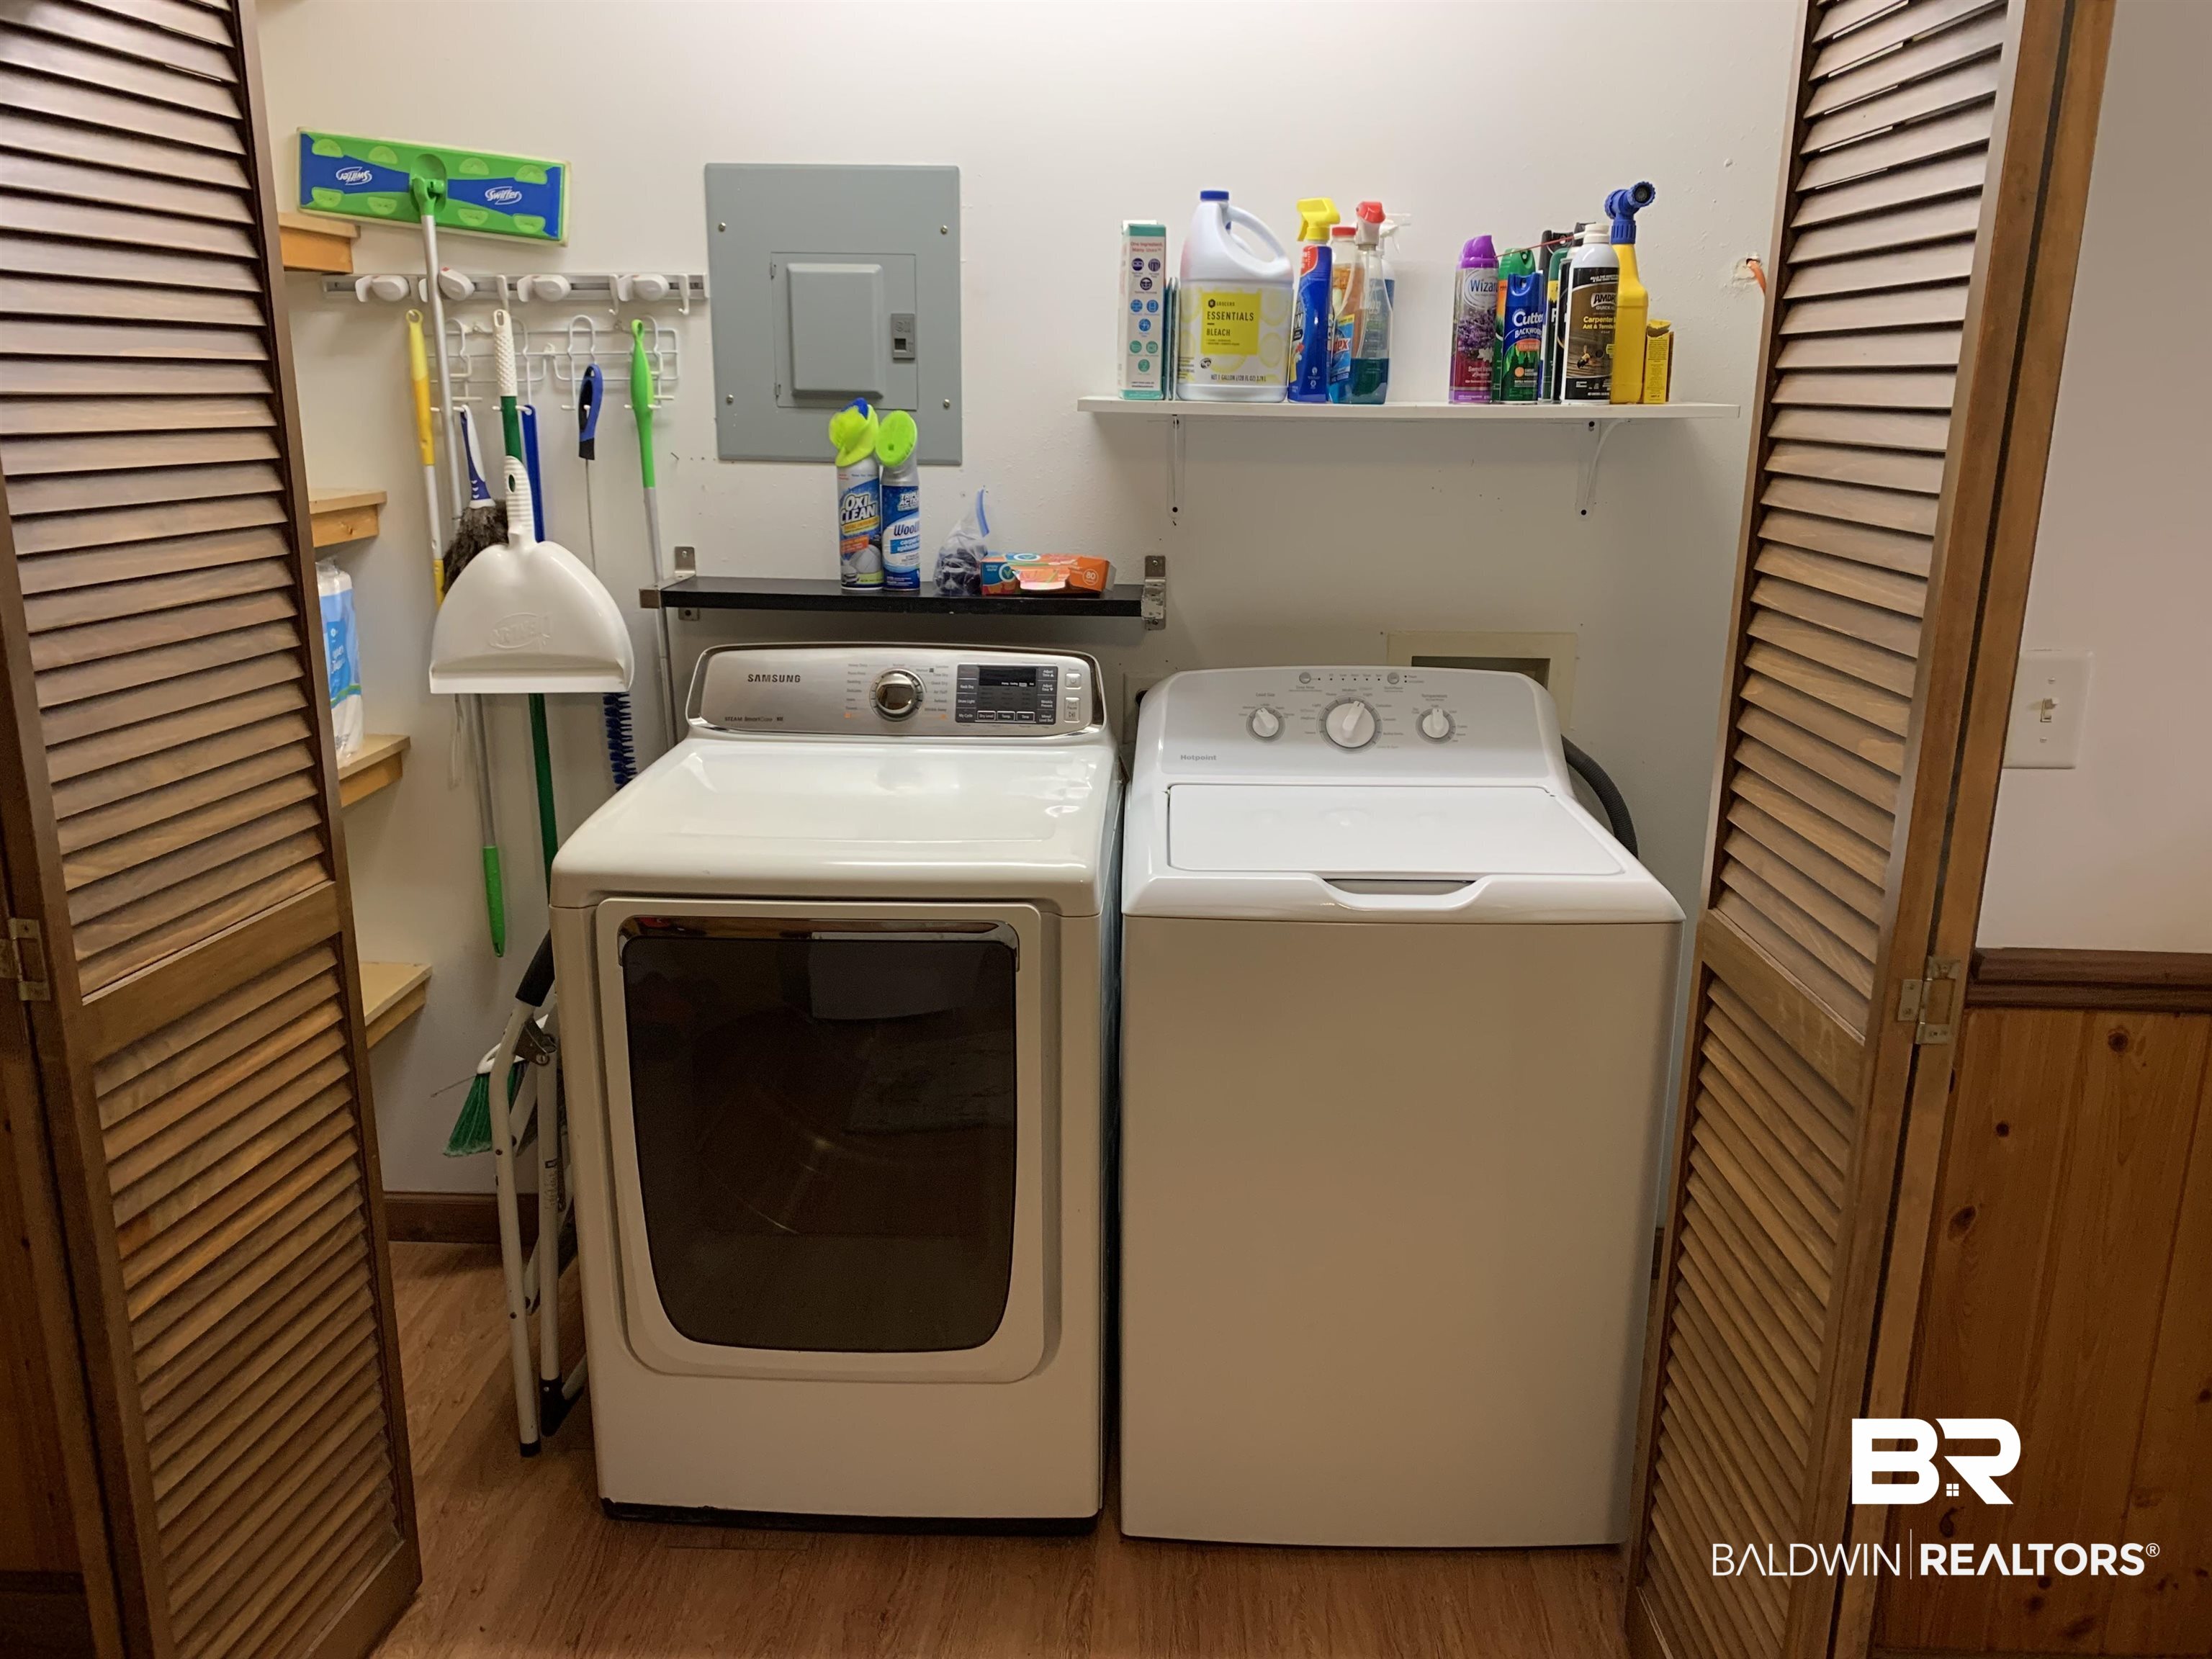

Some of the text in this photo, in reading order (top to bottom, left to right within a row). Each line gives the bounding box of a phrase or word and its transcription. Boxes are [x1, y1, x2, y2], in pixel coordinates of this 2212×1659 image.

[486, 188, 521, 202] Swiffer
[1207, 310, 1254, 322] ESSENTIALS
[1514, 310, 1543, 327] Cutte
[1583, 315, 1613, 324] Carpenter
[1206, 328, 1231, 337] BLEACH
[845, 494, 868, 512] OXI
[840, 503, 876, 525] CLEAN
[1085, 571, 1096, 580] 80
[747, 673, 801, 683] SAMSUNG
